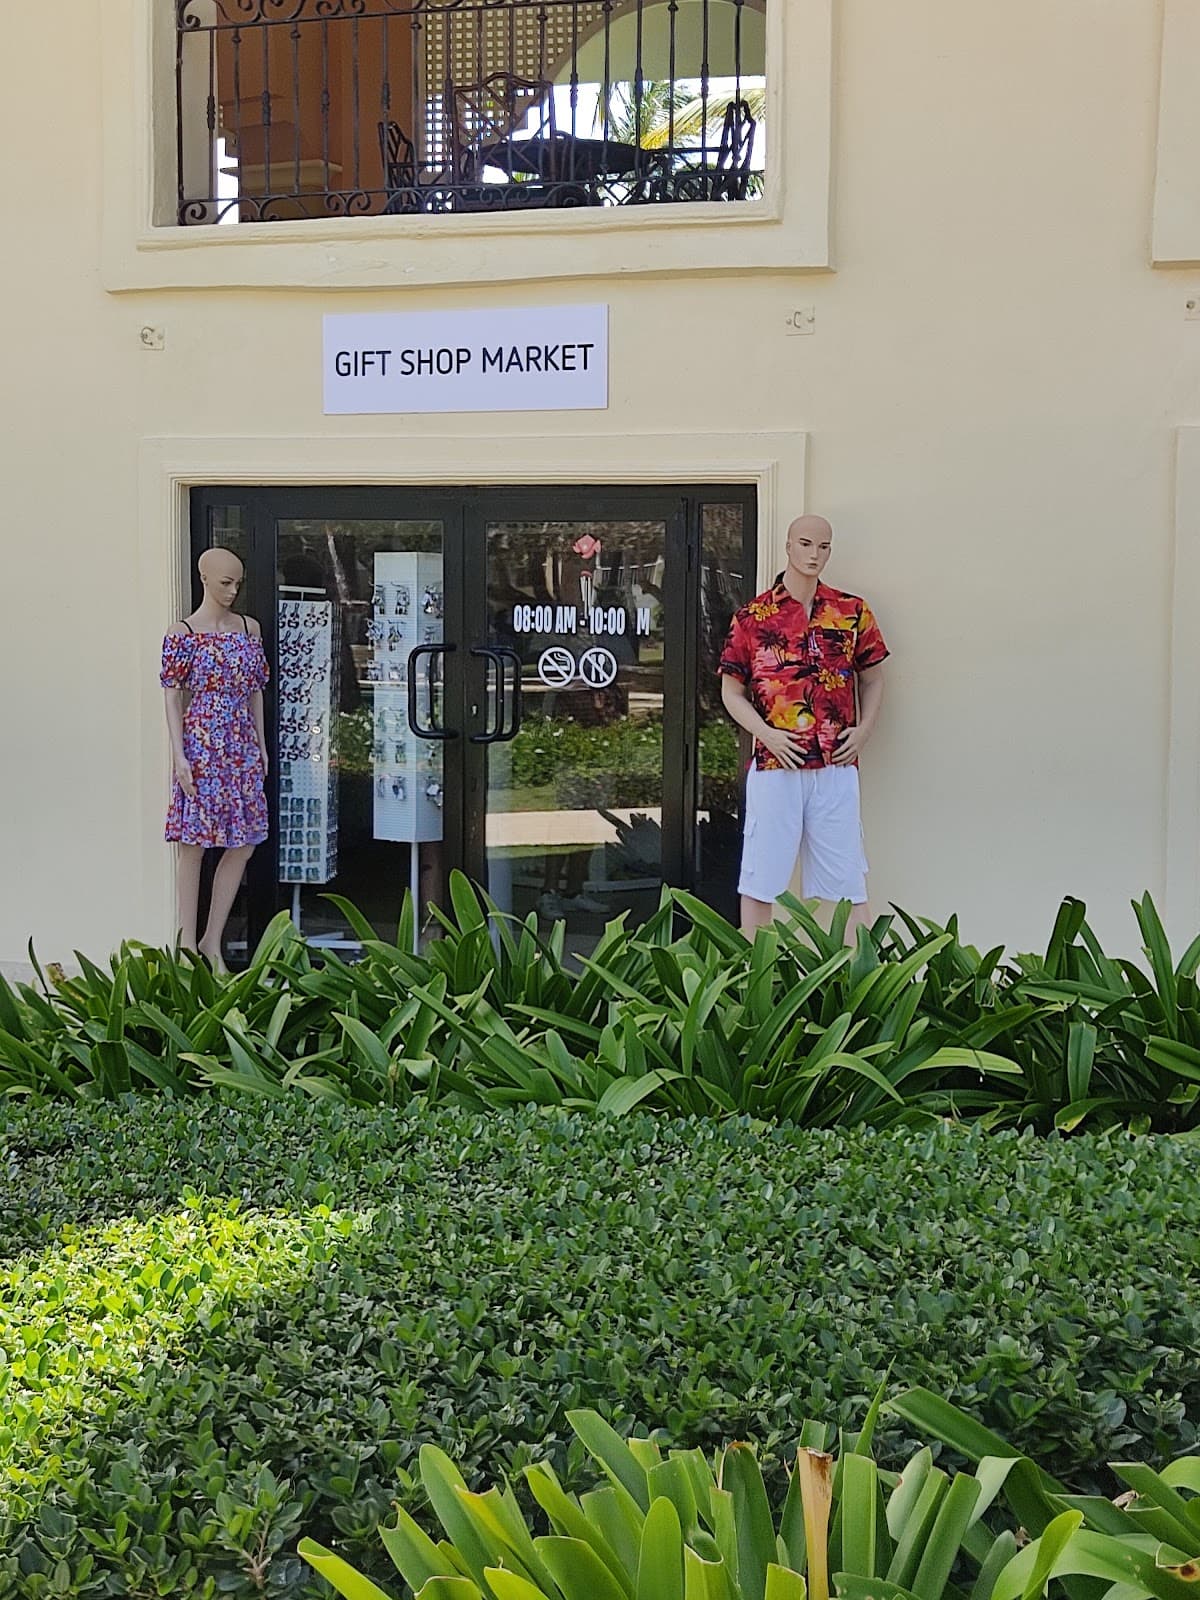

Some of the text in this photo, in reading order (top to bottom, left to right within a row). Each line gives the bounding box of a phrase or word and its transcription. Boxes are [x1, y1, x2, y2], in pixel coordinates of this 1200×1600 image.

[335, 343, 594, 377] GIFT SHOP MARKET
[513, 605, 552, 633] 08:00
[555, 606, 577, 634] AM
[589, 607, 626, 635] 10:00
